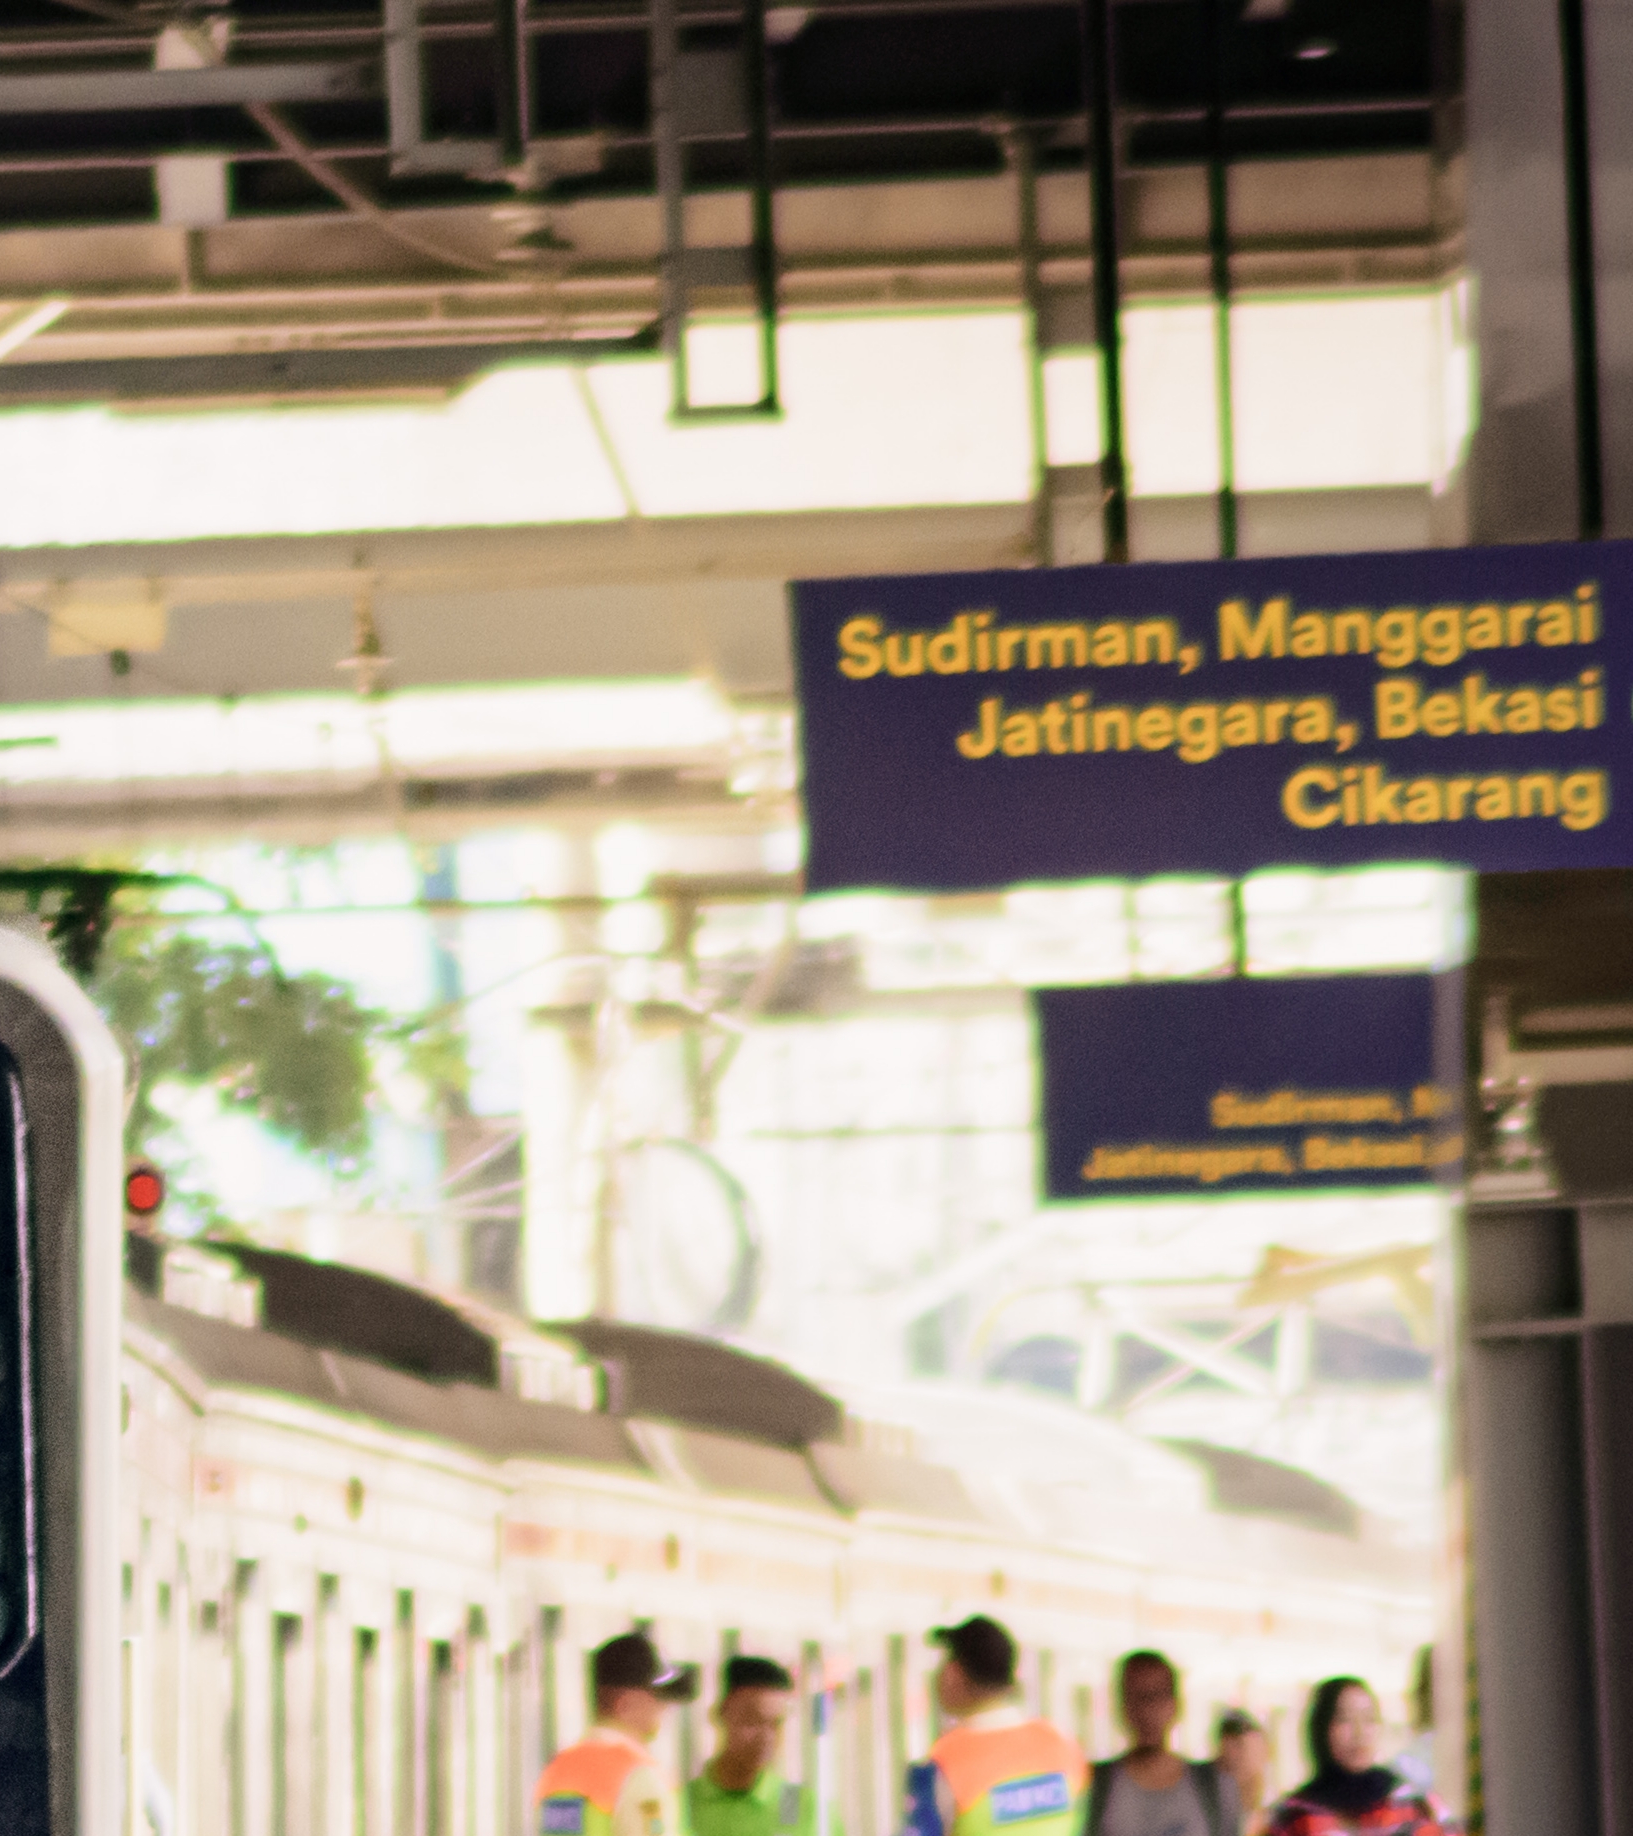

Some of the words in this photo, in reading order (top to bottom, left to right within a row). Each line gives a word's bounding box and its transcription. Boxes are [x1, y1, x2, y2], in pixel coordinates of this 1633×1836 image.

[838, 612, 1200, 678] Sudirman,
[1219, 584, 1596, 667] Manggarai
[956, 692, 1357, 762] Jatinegara,
[1375, 670, 1601, 739] Bekasi
[1282, 765, 1607, 830] Cikarang
